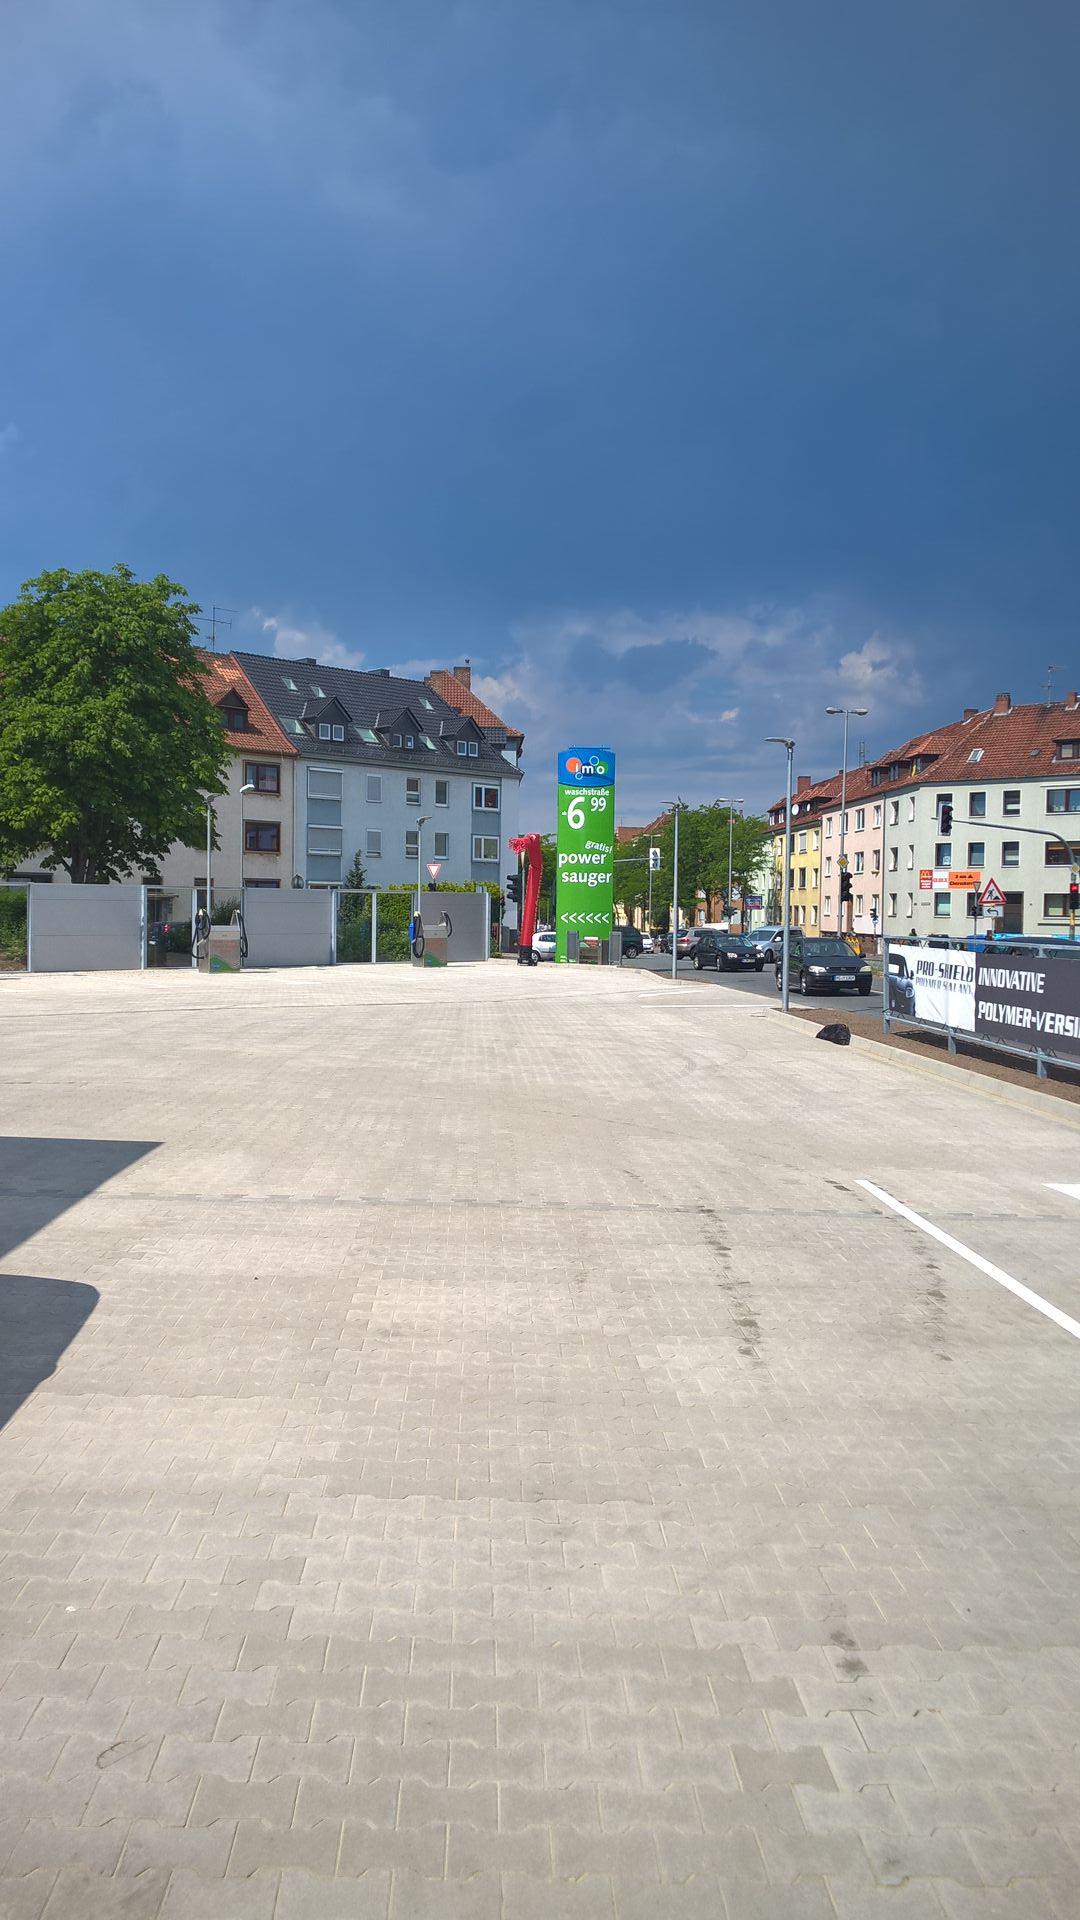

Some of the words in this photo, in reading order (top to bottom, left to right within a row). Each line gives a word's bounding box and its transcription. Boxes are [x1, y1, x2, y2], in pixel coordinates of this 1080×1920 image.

[575, 762, 605, 775] imo
[564, 788, 610, 796] waschstraße
[567, 796, 585, 830] 6
[590, 797, 607, 812] 99
[584, 840, 613, 854] gratis!
[558, 853, 607, 868] power
[561, 871, 612, 887] sauger
[916, 960, 974, 982] PRO-SHIELD
[978, 967, 1046, 994] INNOVATIVE
[977, 1000, 1080, 1039] POLYMER-VERSI
